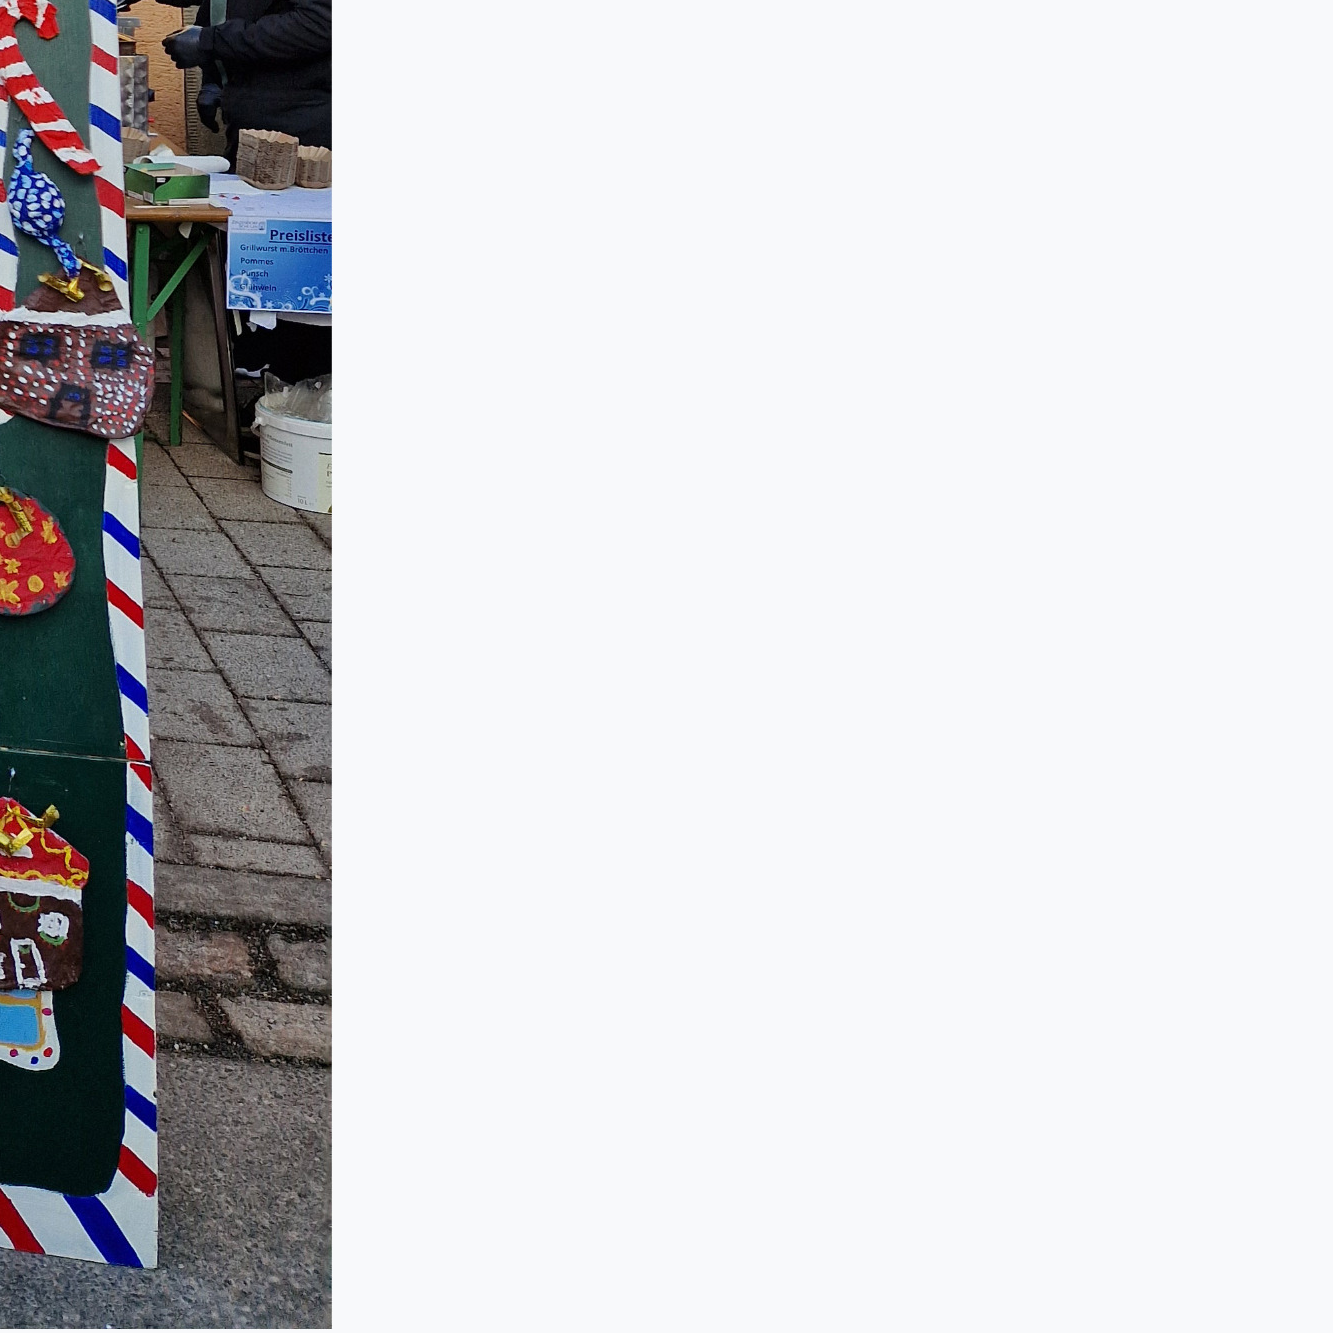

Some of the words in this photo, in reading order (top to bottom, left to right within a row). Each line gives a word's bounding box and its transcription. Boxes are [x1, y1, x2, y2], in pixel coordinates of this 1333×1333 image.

[239, 244, 278, 253] Grillwurst
[240, 257, 274, 266] Pommes
[241, 269, 269, 278] Punsch
